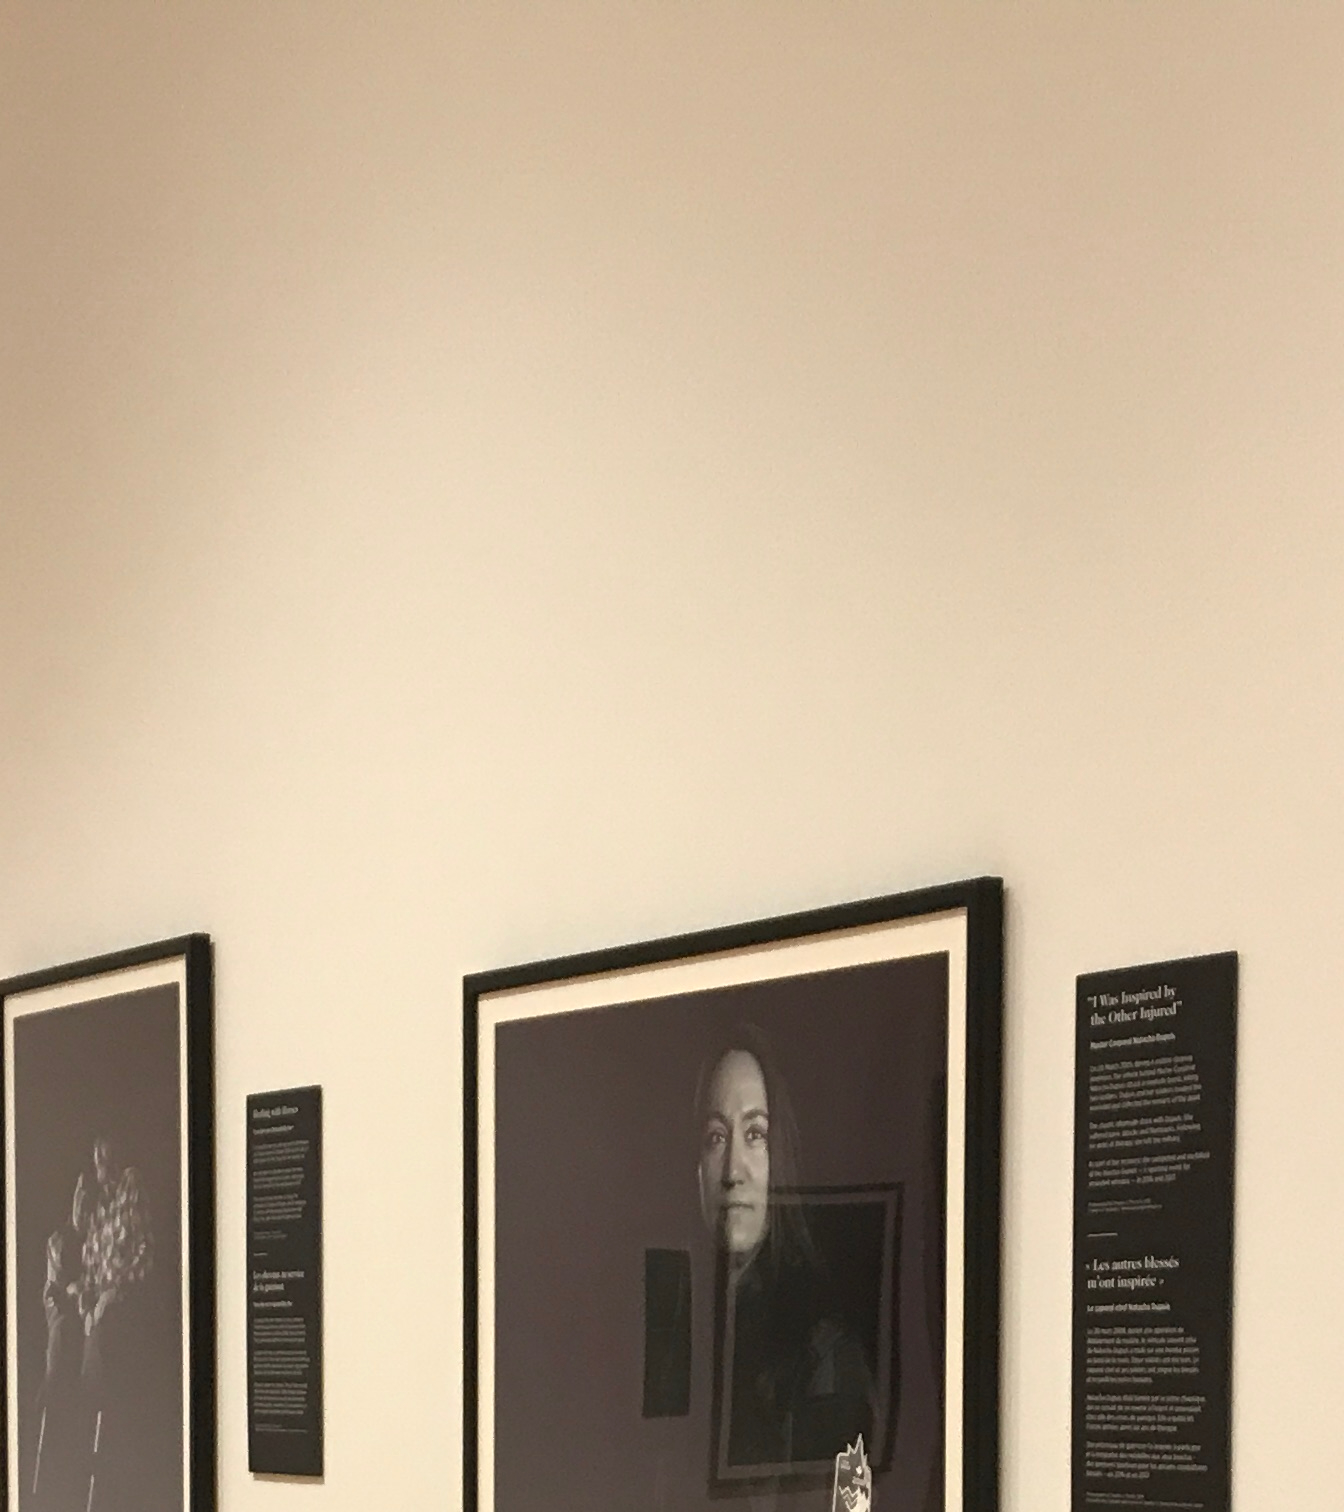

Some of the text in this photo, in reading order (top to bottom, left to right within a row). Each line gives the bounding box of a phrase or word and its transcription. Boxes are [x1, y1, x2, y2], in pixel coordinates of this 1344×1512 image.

[1100, 993, 1119, 1006] Was
[1121, 986, 1162, 1004] Inspired
[1164, 984, 1176, 999] by
[1090, 1012, 1107, 1026] the
[1108, 1008, 1138, 1023] Other
[1093, 1259, 1110, 1271] Les
[1111, 1259, 1142, 1271] autres
[1144, 1255, 1180, 1269] blessés
[1117, 1274, 1157, 1290] inspirée
